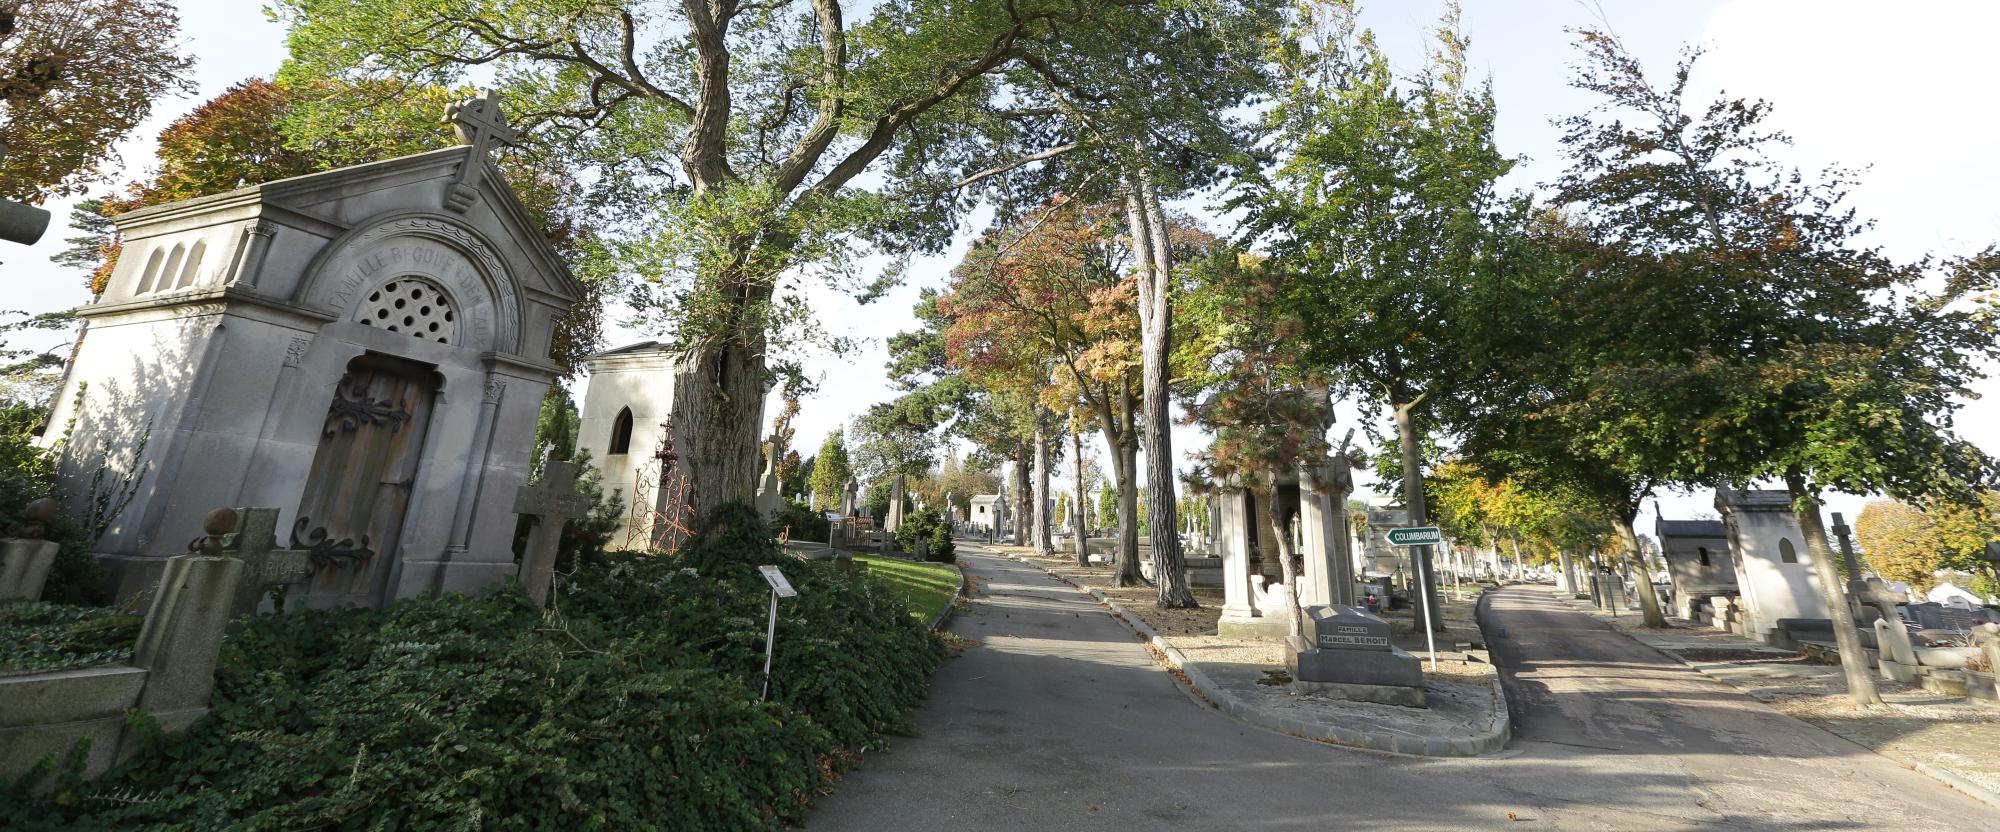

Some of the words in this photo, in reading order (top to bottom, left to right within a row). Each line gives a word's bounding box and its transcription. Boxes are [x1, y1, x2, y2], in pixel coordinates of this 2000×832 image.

[329, 250, 388, 309] FAMILLE
[1394, 531, 1439, 541] COLUMBARIUM
[1338, 626, 1368, 634] FAMILLE
[1320, 634, 1352, 643] MARCEL
[1354, 636, 1388, 645] BENOIT
